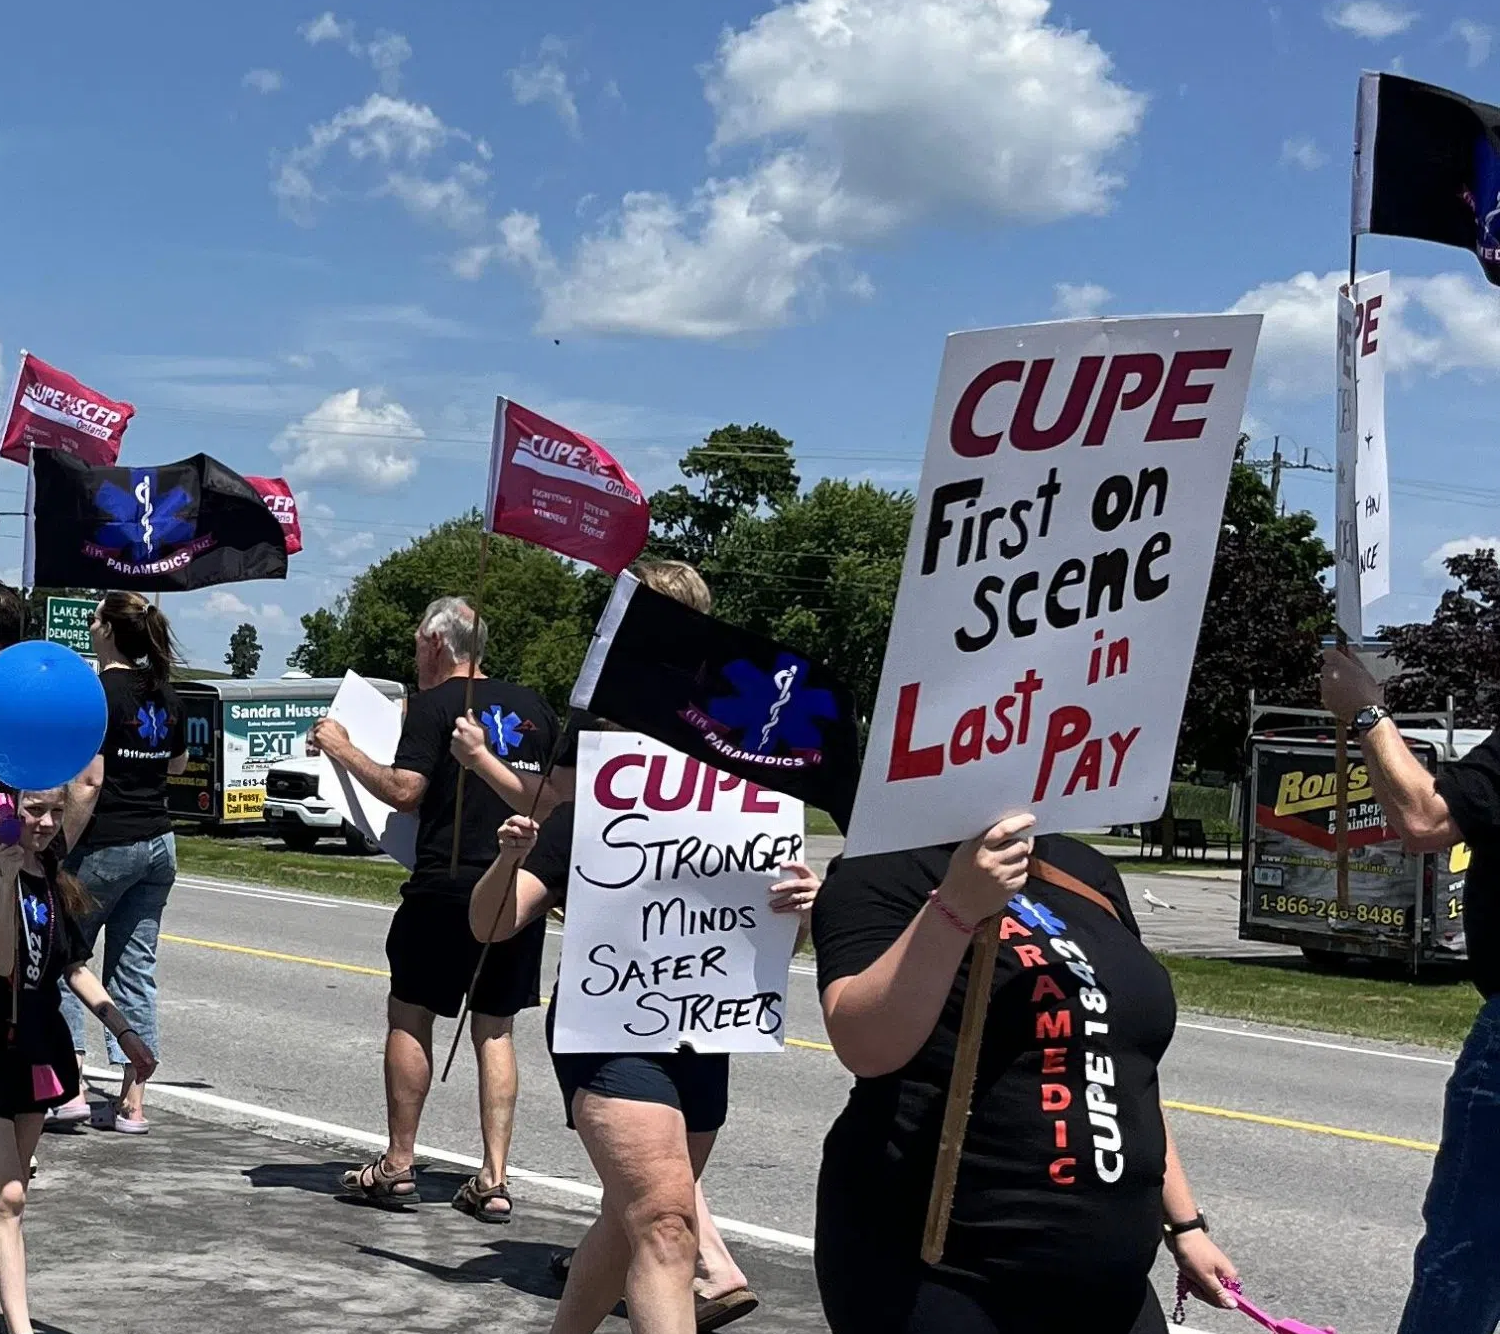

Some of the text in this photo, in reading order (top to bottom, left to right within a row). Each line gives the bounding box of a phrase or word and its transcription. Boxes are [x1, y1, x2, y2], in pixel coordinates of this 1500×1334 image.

[71, 398, 121, 427] SCFP
[949, 348, 1234, 459] CUPE
[76, 419, 109, 439] Ontario
[530, 434, 587, 466] CUPE
[921, 466, 1169, 576] First on
[106, 551, 191, 575] PARAMEDICS
[52, 605, 79, 618] LAKE
[954, 531, 1172, 653] scene
[49, 628, 90, 641] DEMORES
[1087, 628, 1130, 686] in
[231, 704, 281, 719] Sandra
[886, 669, 1043, 782] Last
[704, 731, 805, 766] PARAMEDICS
[1031, 704, 1141, 803] PAY
[594, 753, 781, 814] CUPE
[575, 813, 803, 889] STRONGER
[642, 897, 756, 942] MINDS
[581, 944, 728, 996] SAFER
[623, 991, 783, 1036] STREETS
[1049, 937, 1124, 1184] CUPE 1842
